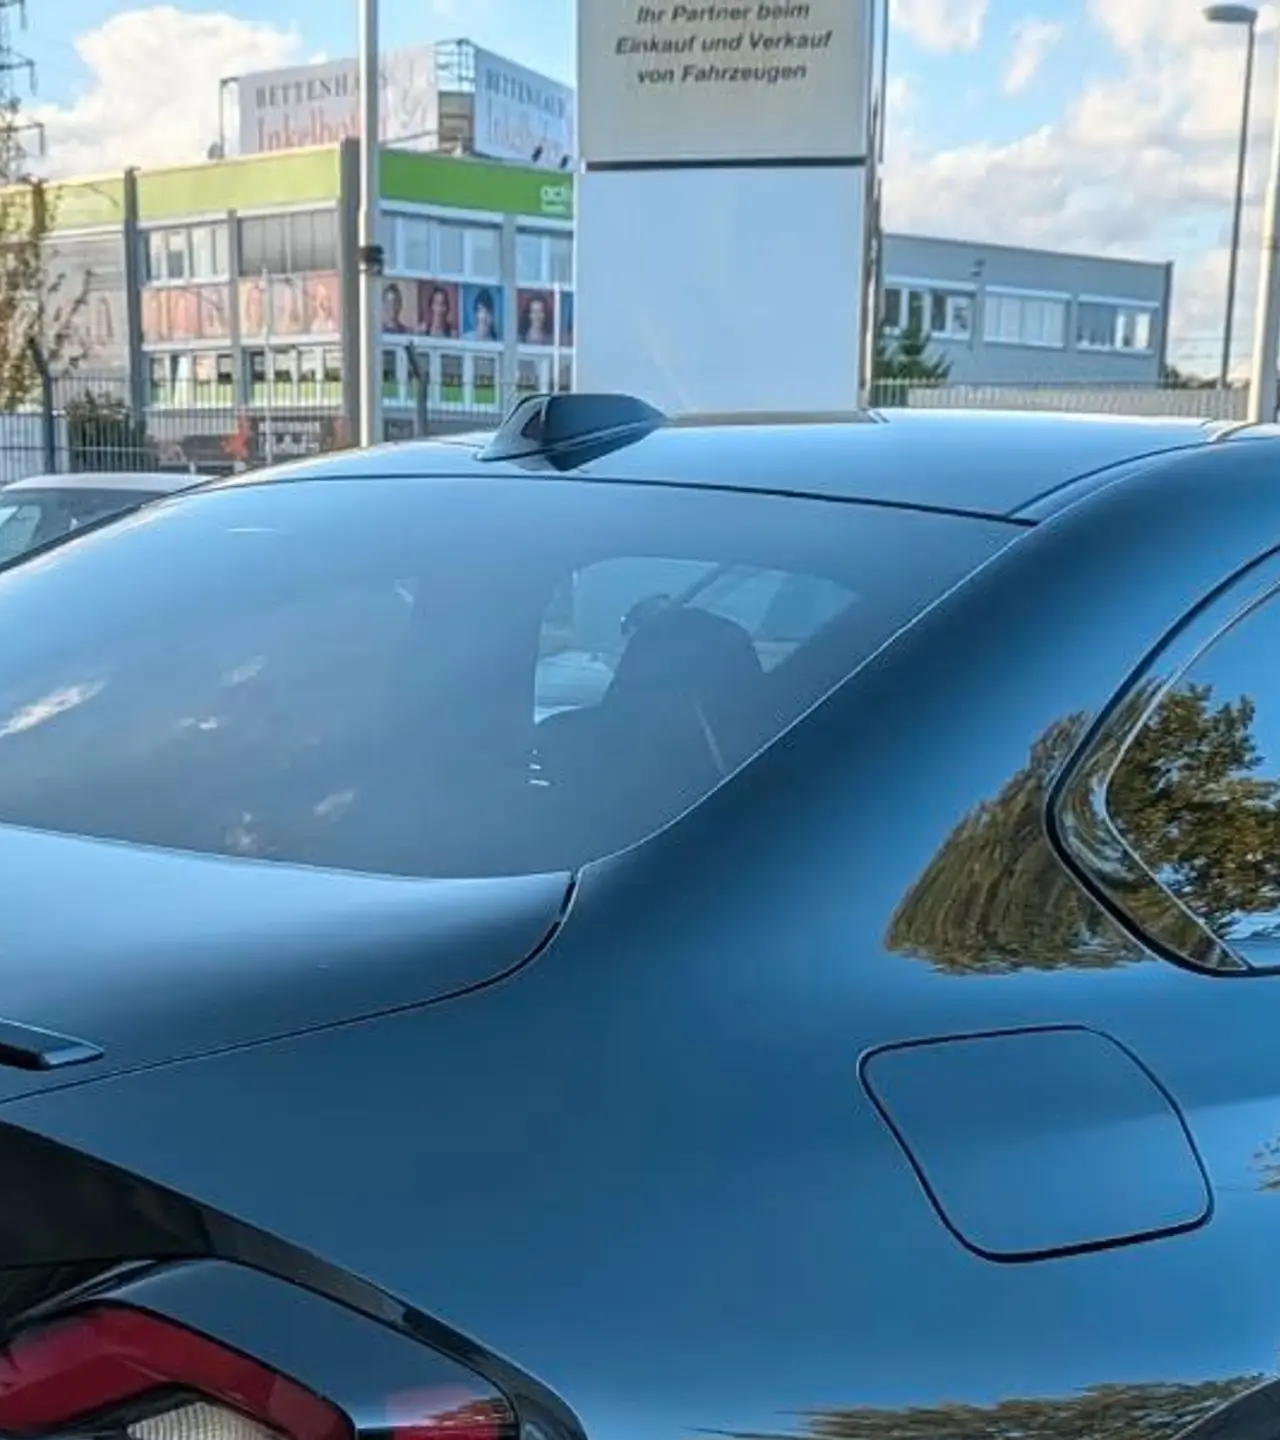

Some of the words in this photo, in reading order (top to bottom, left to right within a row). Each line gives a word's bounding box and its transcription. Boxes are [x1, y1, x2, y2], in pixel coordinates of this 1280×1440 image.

[636, 6, 665, 24] Ihr
[671, 4, 752, 22] Partner
[756, 1, 810, 21] beim
[615, 36, 697, 55] Einkauf
[701, 33, 744, 51] und
[749, 30, 833, 50] Verkauf
[637, 69, 675, 84] von
[681, 64, 807, 84] Fahrzeugen
